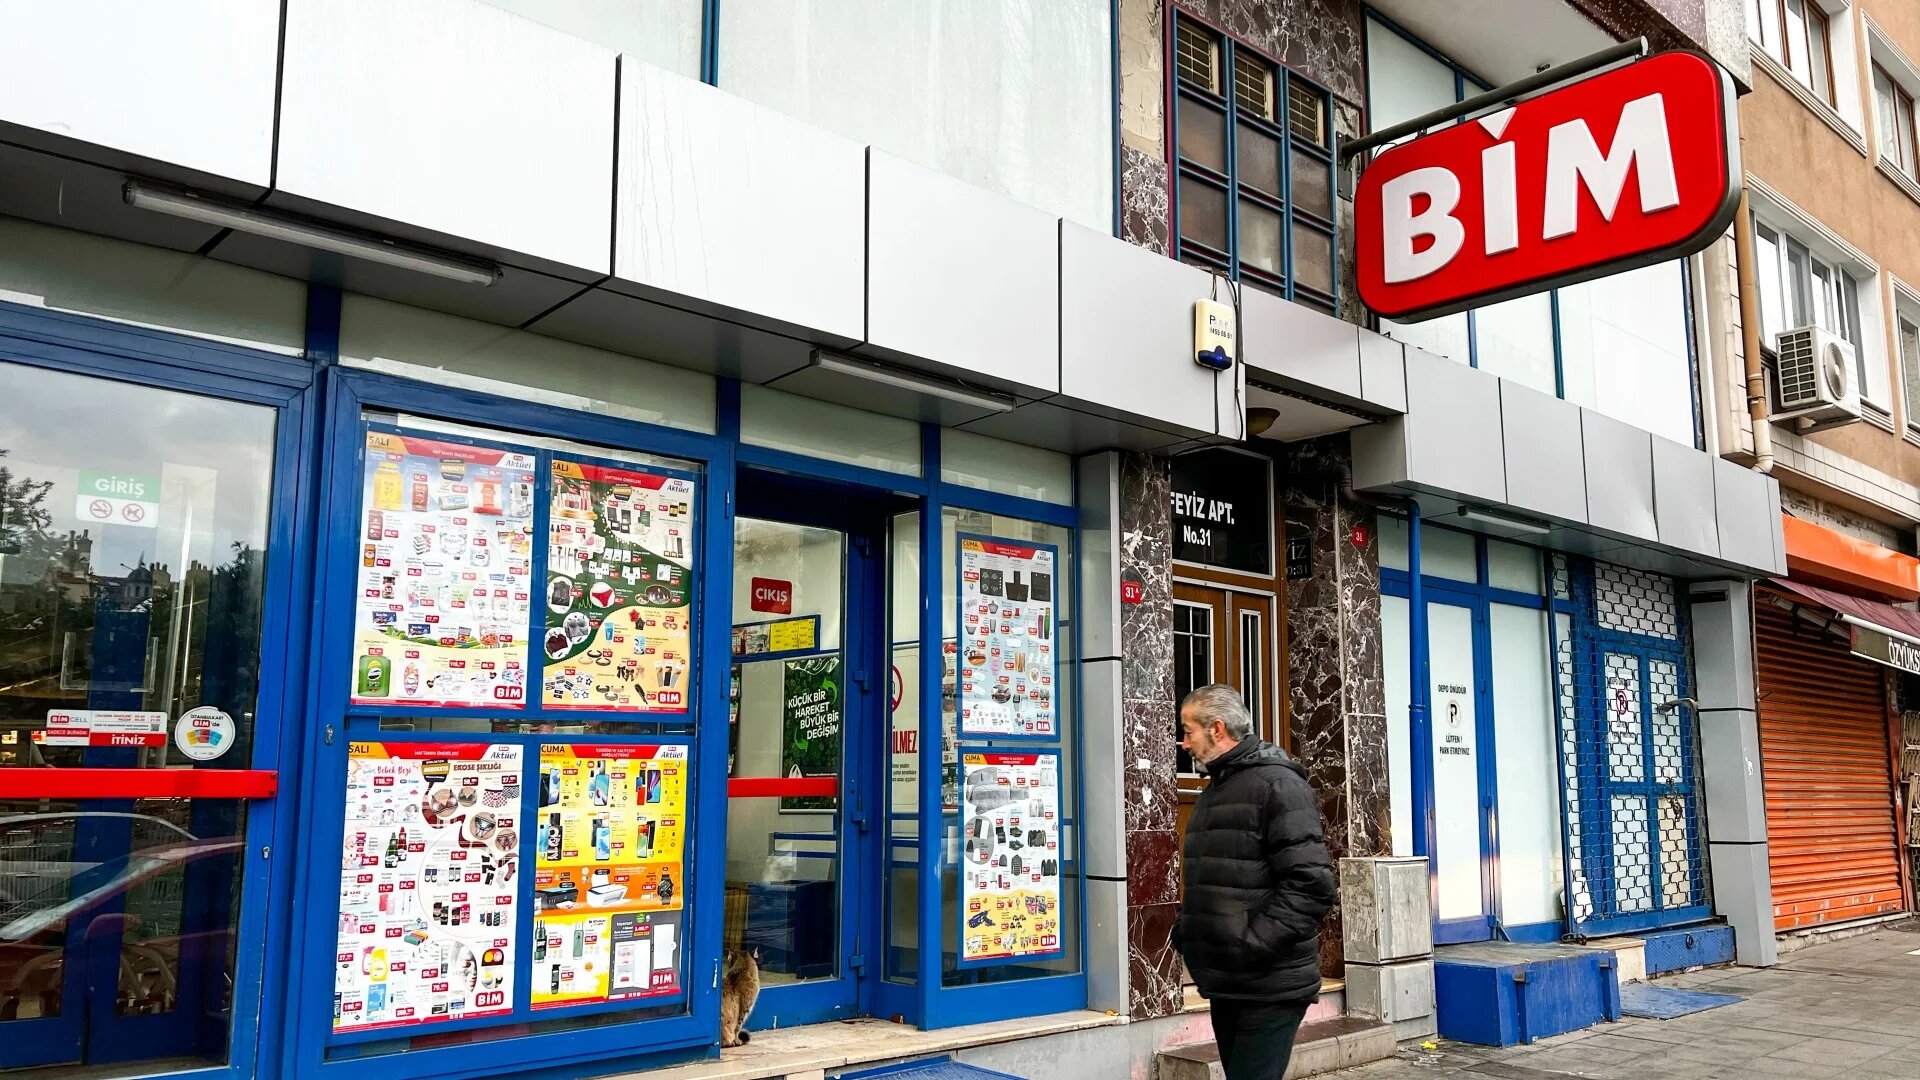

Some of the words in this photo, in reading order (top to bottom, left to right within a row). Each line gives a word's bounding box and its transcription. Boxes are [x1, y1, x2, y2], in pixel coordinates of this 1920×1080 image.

[1382, 93, 1680, 284] BİM
[368, 436, 389, 446] SALI
[505, 460, 532, 469] Aktüel
[95, 476, 145, 498] GİRİŞ
[666, 484, 690, 494] Aktüel
[1208, 499, 1235, 525] APT.
[1183, 524, 1210, 547] No.31
[1355, 531, 1363, 542] 31
[755, 587, 788, 605] ÇIKIŞ
[1888, 636, 1920, 672] ÖZYÜKS
[788, 693, 813, 709] KÜÇÜK
[813, 688, 826, 702] BİR
[795, 701, 830, 719] HAREKET
[800, 713, 827, 730] BÜYÜK
[348, 744, 369, 754] SALI
[541, 745, 565, 753] CUMA
[660, 750, 684, 759] Aktüel
[490, 751, 517, 760] Aktüel
[377, 766, 395, 775] Bebek
[453, 764, 475, 772] EKOSE
